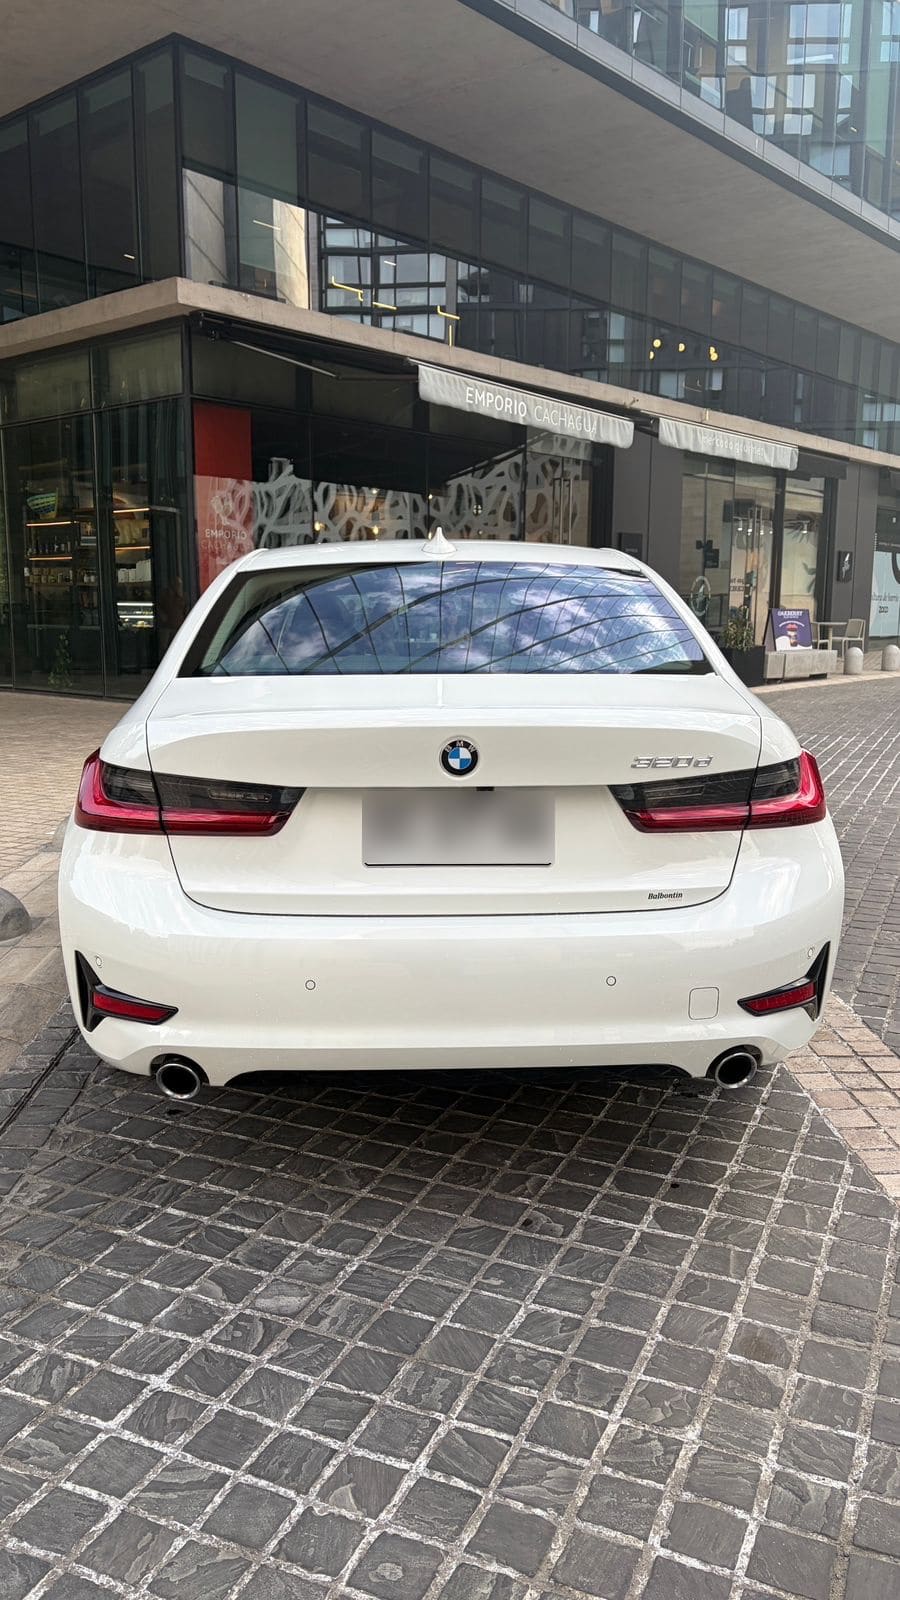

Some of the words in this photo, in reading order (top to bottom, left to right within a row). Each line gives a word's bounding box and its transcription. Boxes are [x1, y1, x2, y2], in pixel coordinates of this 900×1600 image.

[465, 386, 527, 417] EMPORIO
[534, 405, 598, 433] CACHAGUA
[205, 529, 247, 540] EMPORIO
[444, 740, 477, 753] BMW
[631, 754, 714, 769] 320d
[647, 891, 683, 900] Balbontin
